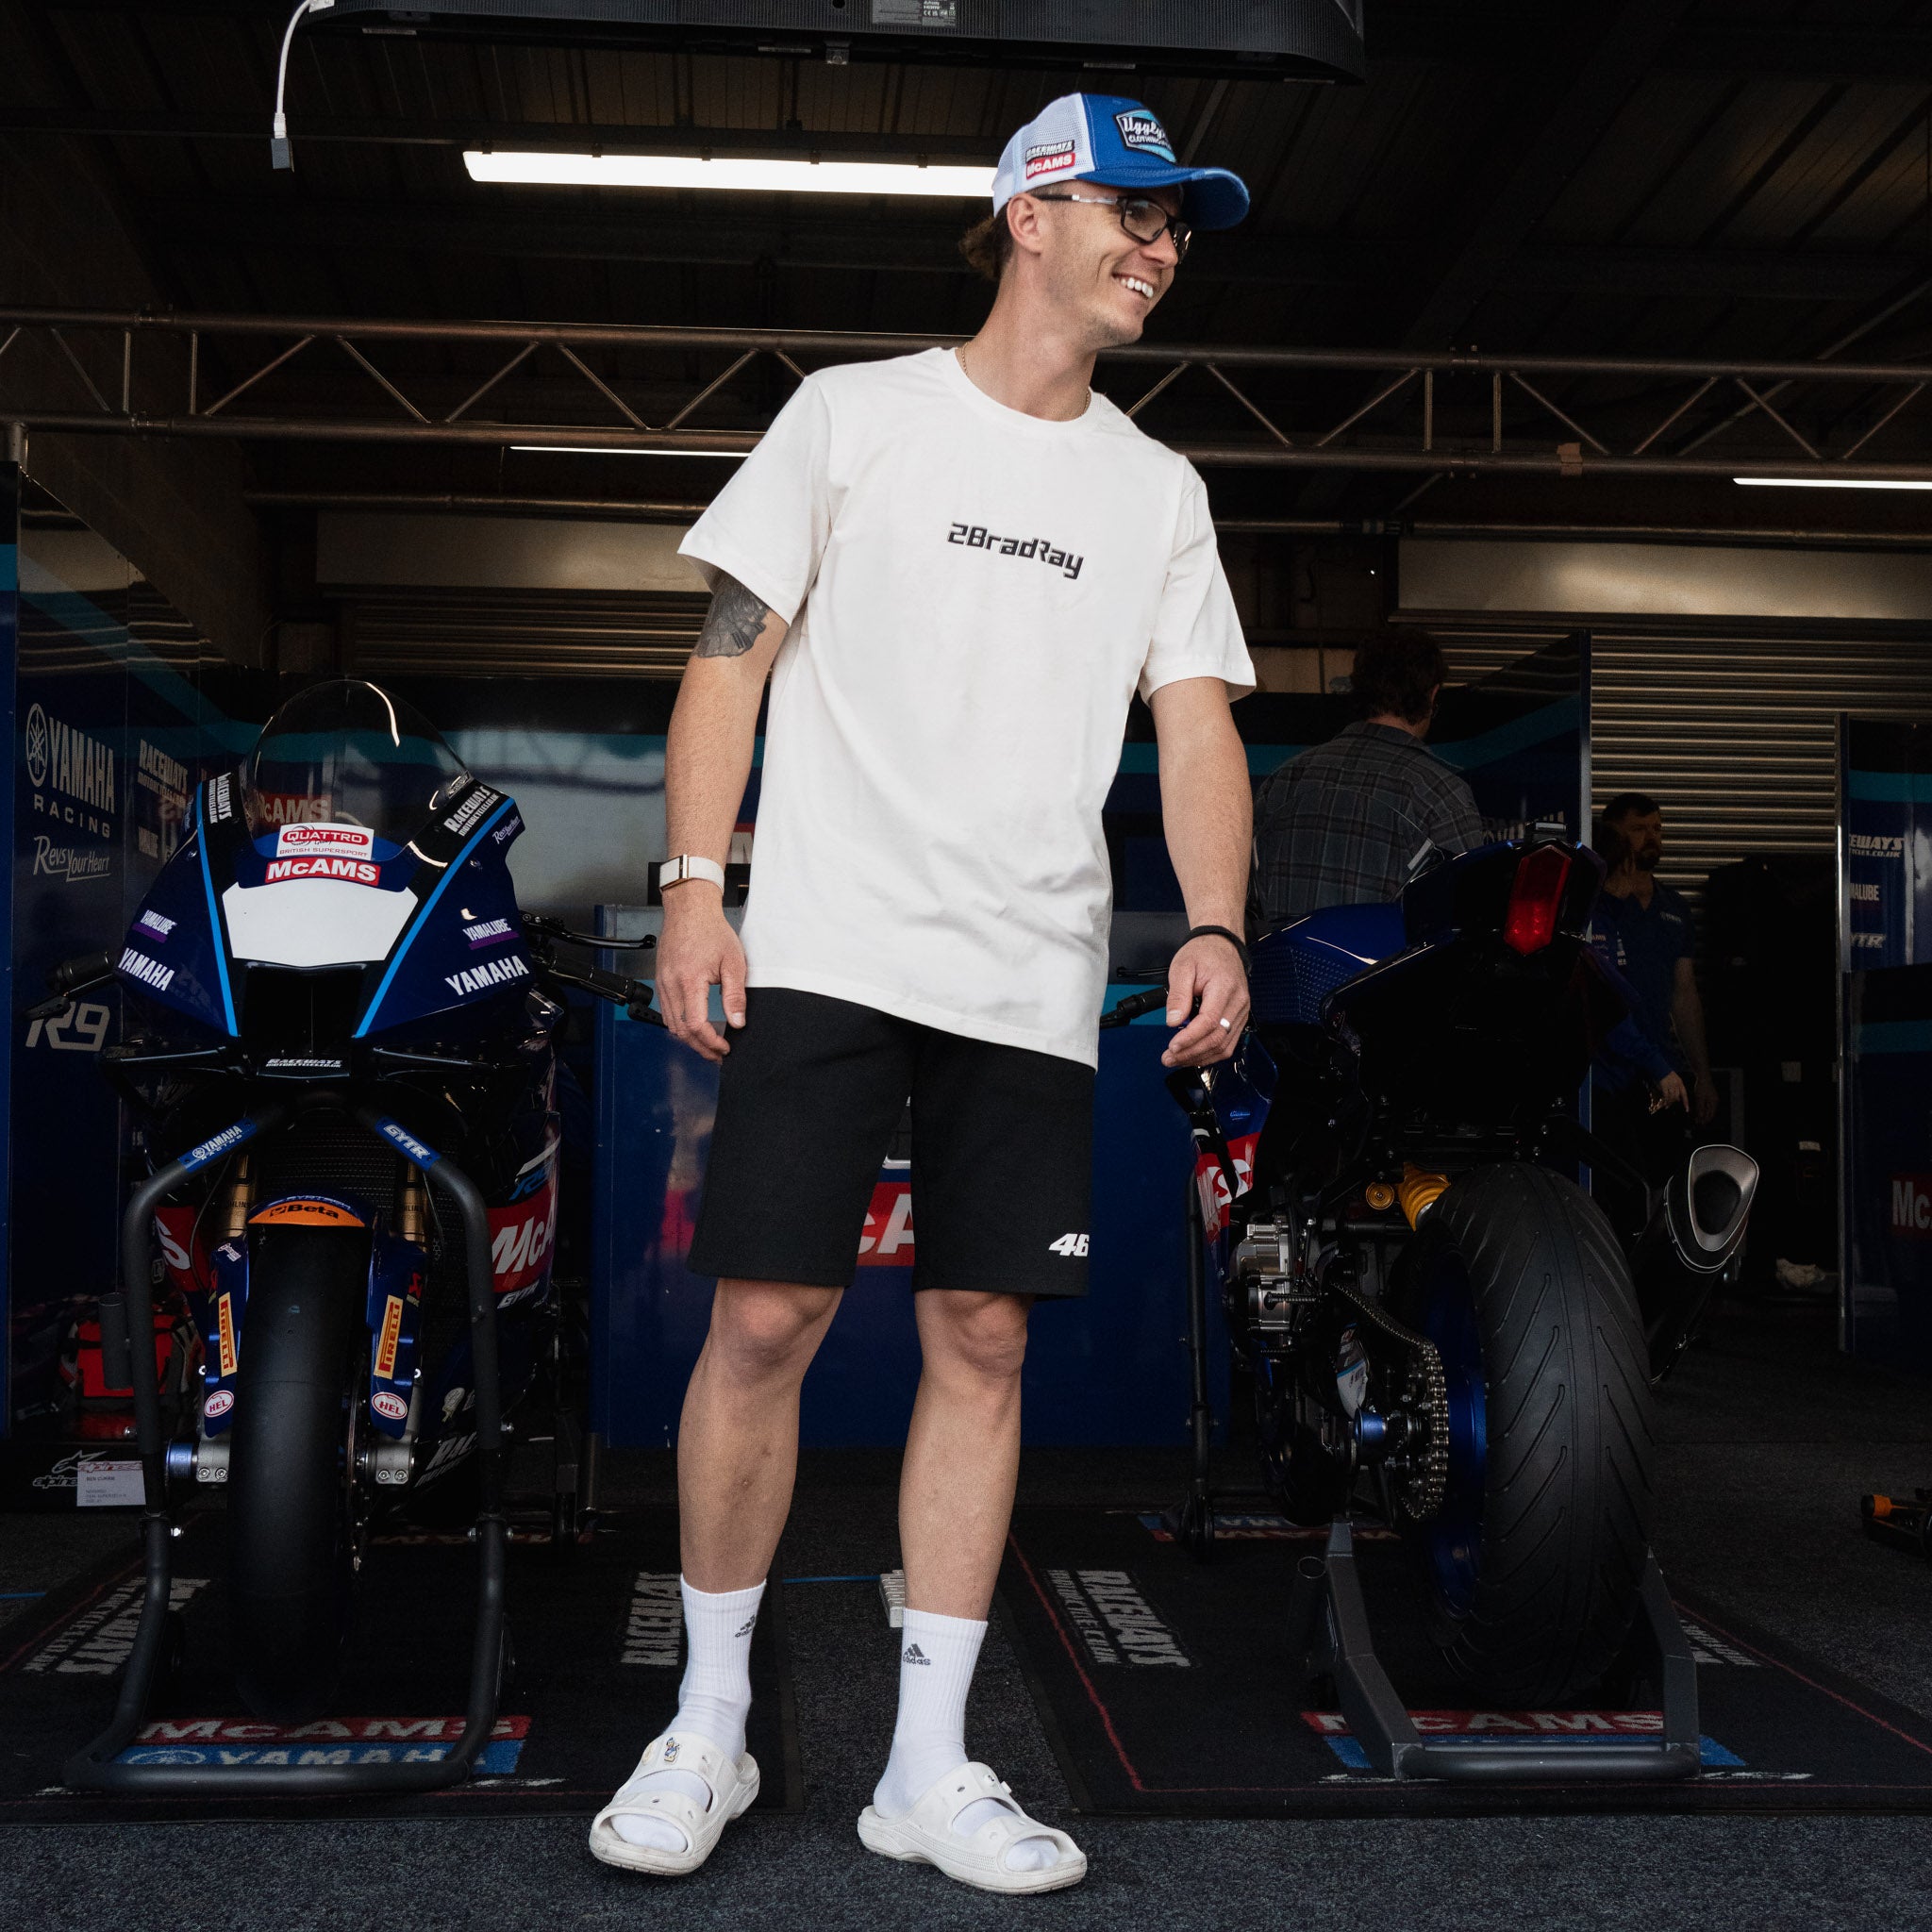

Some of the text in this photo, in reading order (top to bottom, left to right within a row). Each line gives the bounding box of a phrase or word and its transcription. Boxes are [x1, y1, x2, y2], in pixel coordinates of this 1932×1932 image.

[1027, 154, 1073, 177] McAMS
[49, 716, 115, 814] YAMAHA
[33, 793, 110, 839] RACING
[443, 786, 491, 833] RACEWAYS
[287, 831, 363, 843] QUATTRO
[312, 848, 369, 858] SUPERSPORT
[267, 858, 376, 882] McAMS
[462, 918, 512, 941] YAMALUBE
[118, 947, 175, 991] YAMAHA
[444, 955, 529, 996] YAMAHA
[202, 1125, 242, 1152] YAMAHA
[383, 1124, 430, 1160] GYTR
[287, 1204, 340, 1219] Beta
[1891, 1179, 1932, 1229] Mc
[220, 1299, 234, 1371] PIRELLI
[378, 1302, 400, 1373] PIRELLI
[208, 1399, 228, 1413] HEL
[379, 1401, 401, 1415] HEL
[1074, 1570, 1191, 1668] RACEWAYS
[137, 1720, 515, 1740] McAMS
